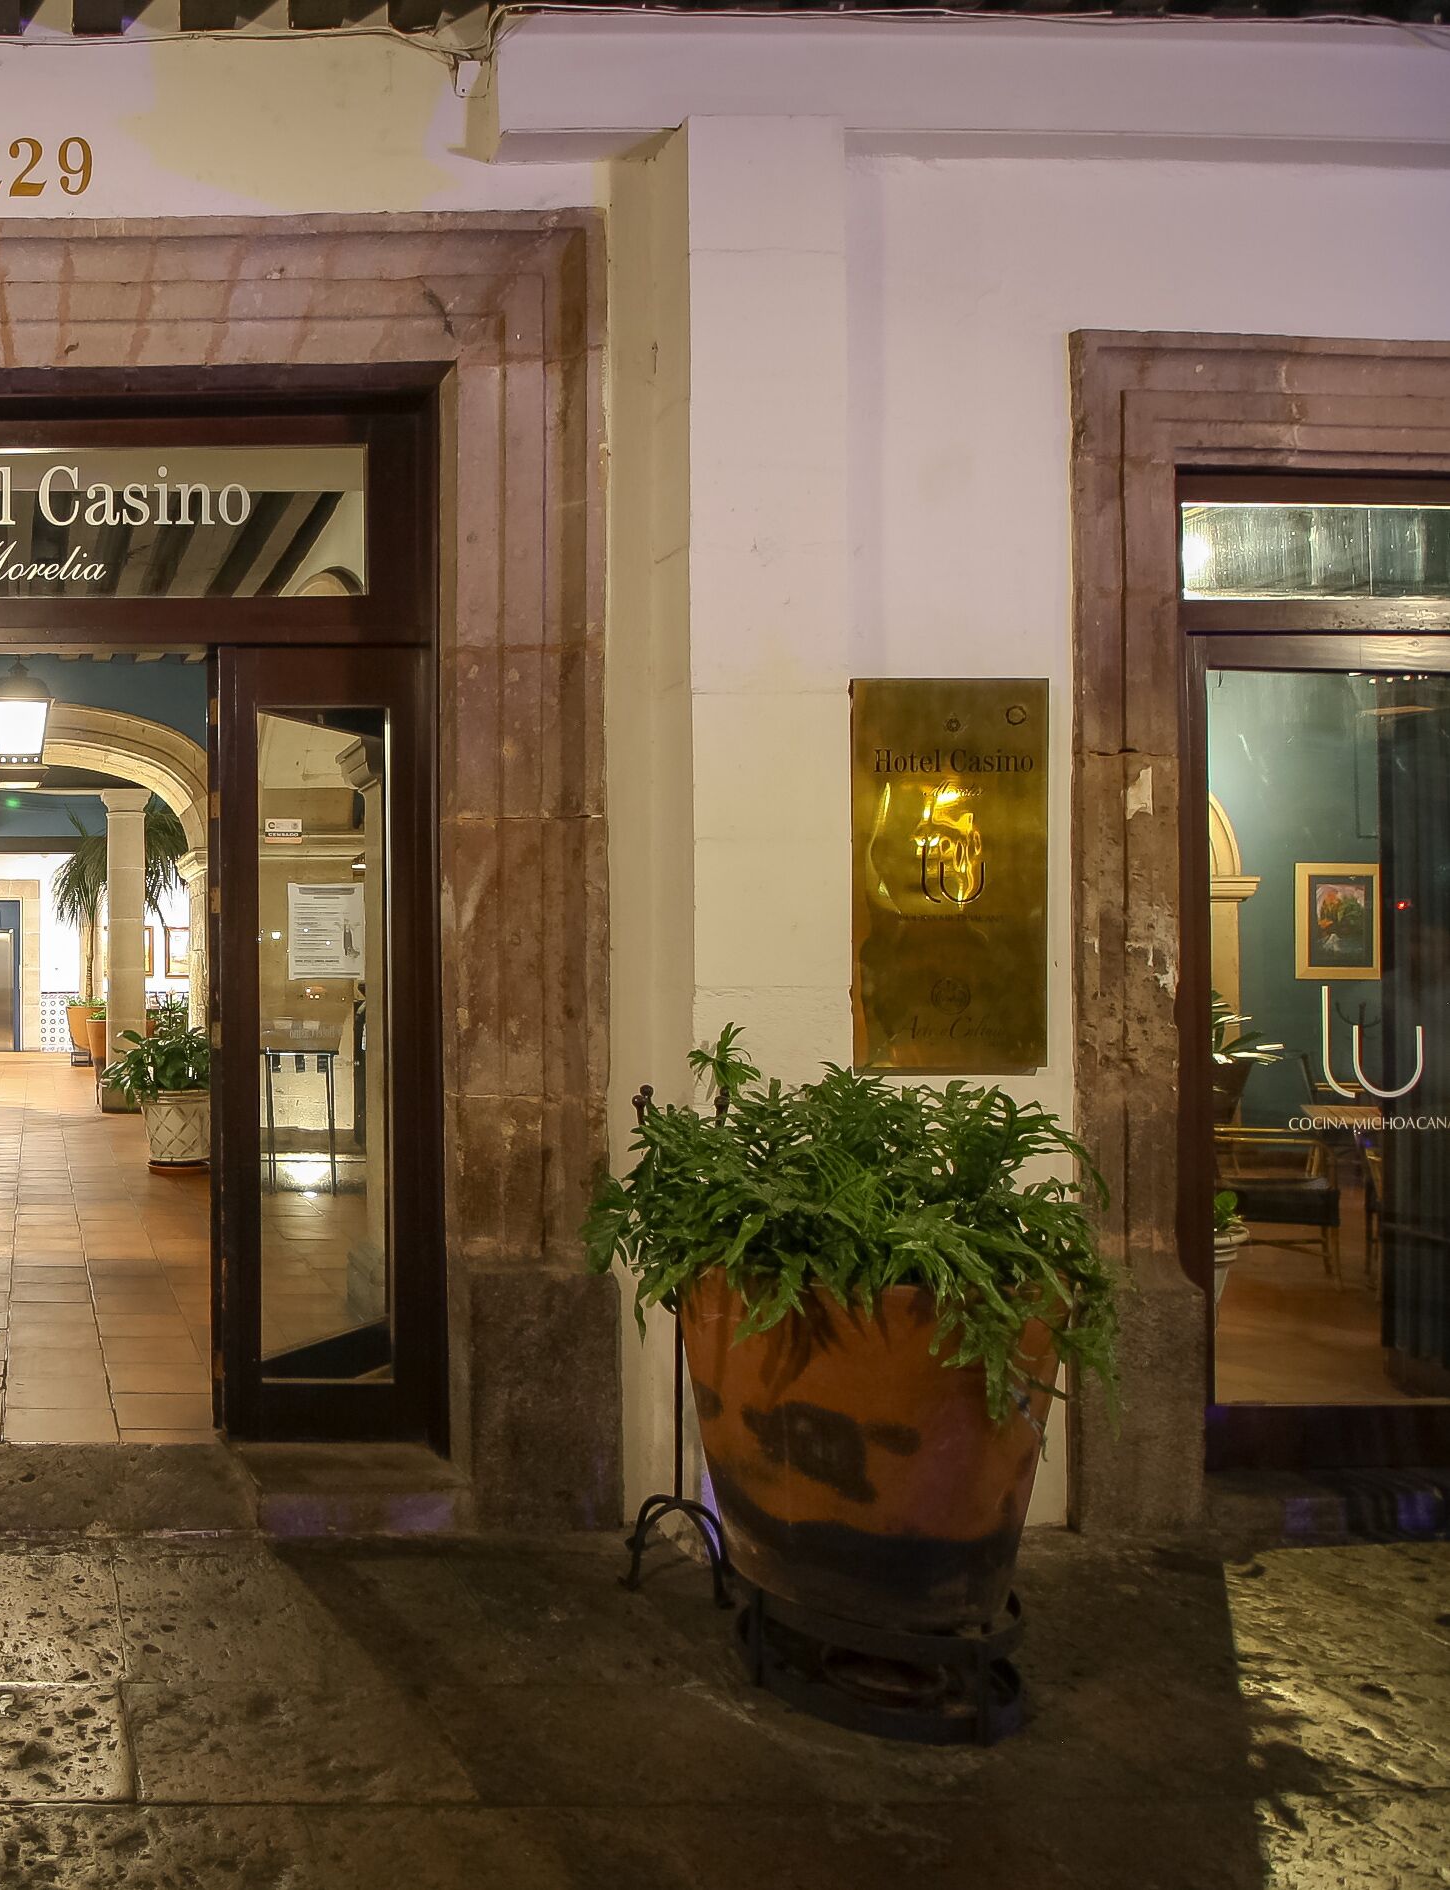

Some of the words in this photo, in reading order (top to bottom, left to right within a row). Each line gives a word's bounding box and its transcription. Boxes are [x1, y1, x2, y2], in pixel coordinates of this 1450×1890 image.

[38, 465, 251, 527] Casino
[873, 748, 942, 773] Hotel
[950, 748, 1033, 773] Casino
[1288, 1116, 1349, 1132] COCINA
